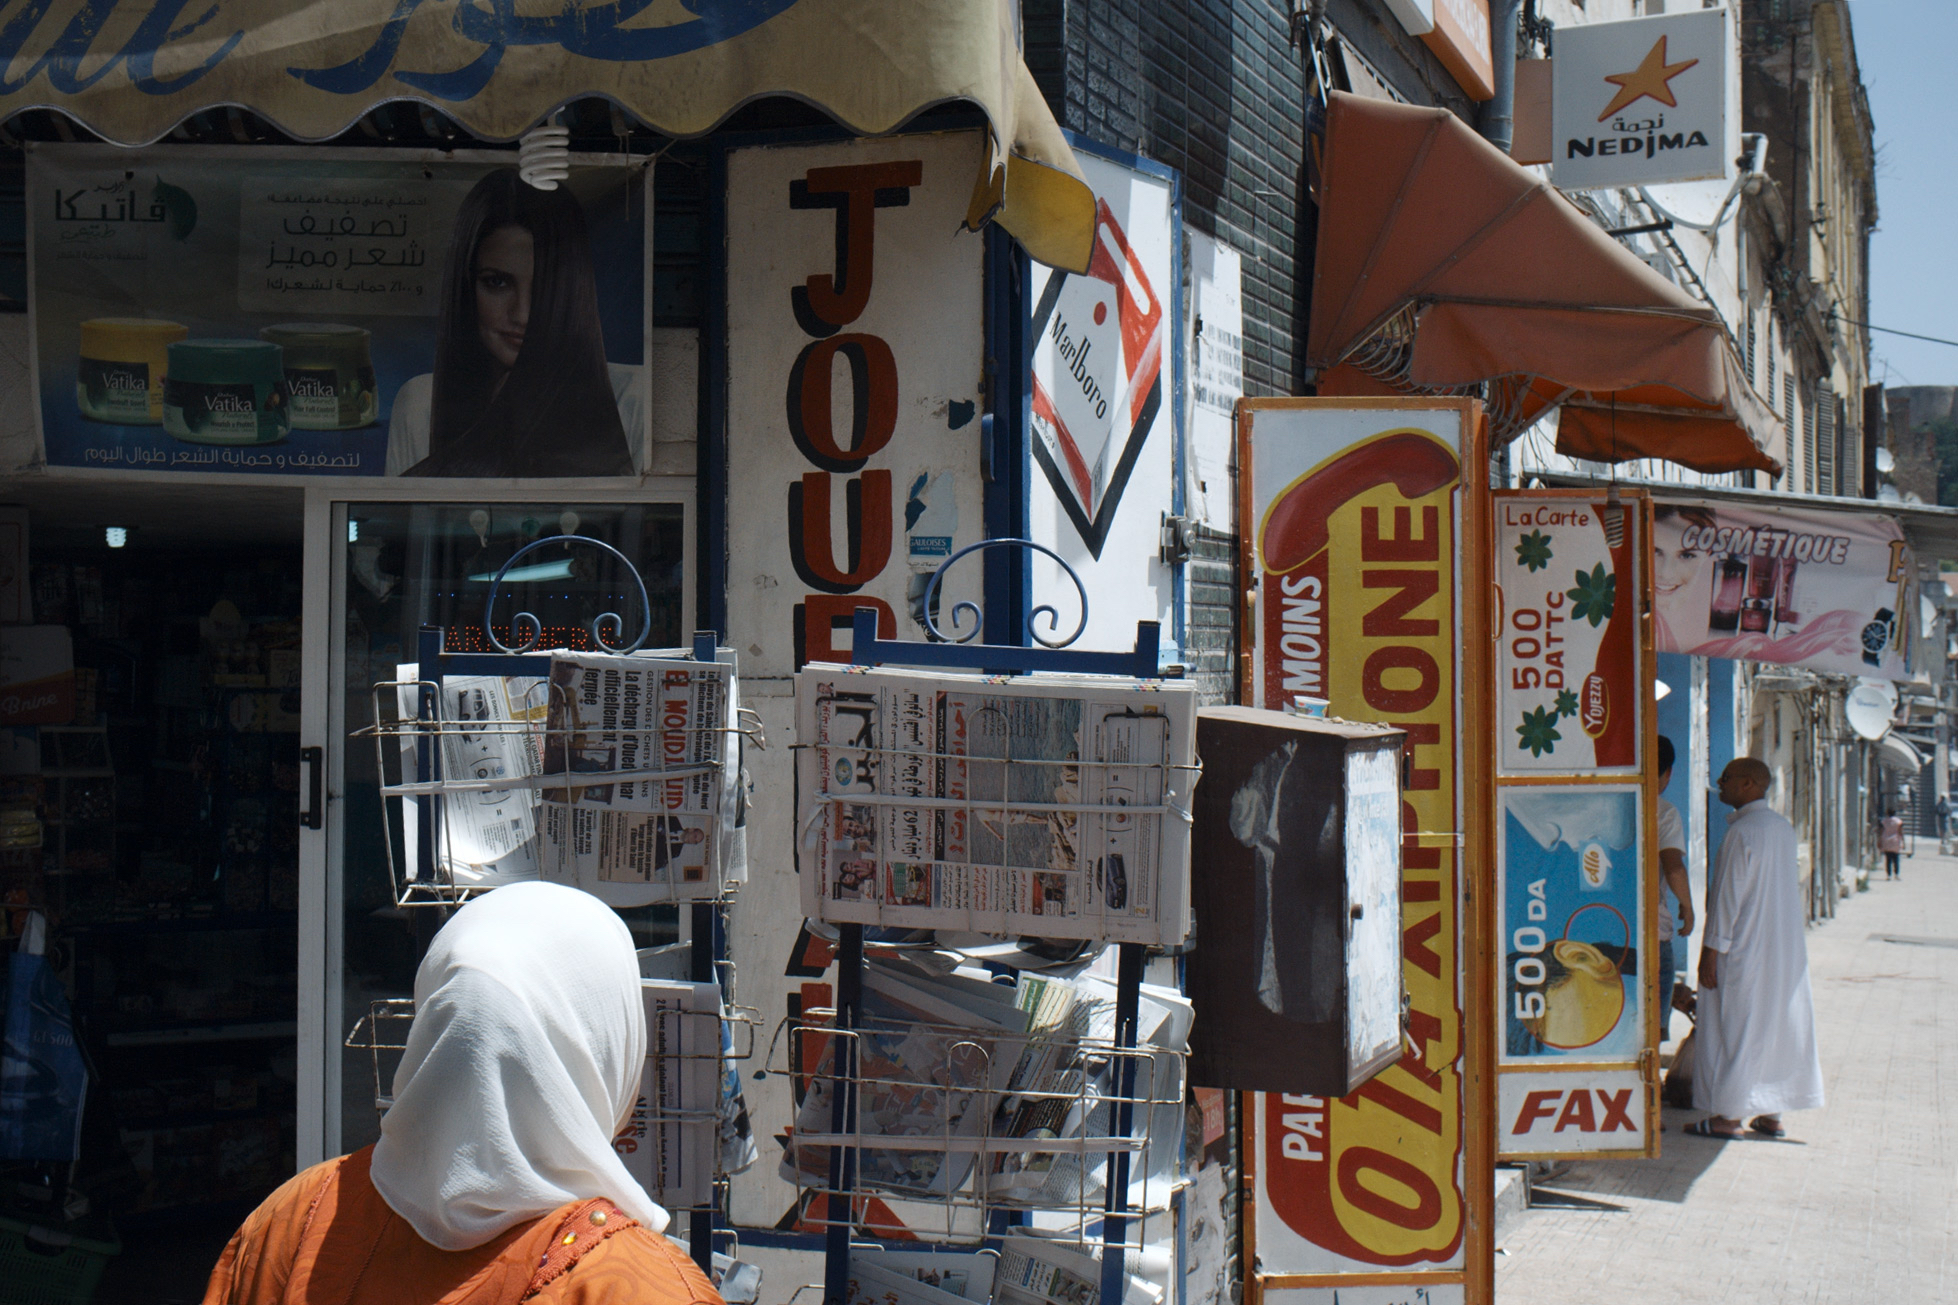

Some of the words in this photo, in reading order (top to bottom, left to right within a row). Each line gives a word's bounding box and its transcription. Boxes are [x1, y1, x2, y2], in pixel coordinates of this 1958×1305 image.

[283, 209, 407, 242] تصفيف
[265, 240, 338, 270] مميز
[343, 239, 425, 271] شعر
[1048, 311, 1108, 420] Marlboro
[102, 372, 147, 392] Vatika
[288, 380, 335, 398] Vatika
[205, 395, 253, 412] Vatika
[84, 445, 124, 463] اليوم
[126, 446, 167, 464] طوال
[169, 446, 219, 466] الشعر
[222, 447, 273, 468] حماية
[276, 454, 285, 469] و
[289, 448, 361, 470] لتصفيف
[1534, 505, 1590, 528] Carte
[1681, 524, 1851, 566] COSMÉTIQUE
[1280, 573, 1323, 693] MOINS
[1511, 607, 1542, 691] 500
[583, 668, 601, 705] fermée
[624, 671, 641, 681] La
[664, 670, 690, 691] EL
[707, 670, 716, 682] Le
[644, 670, 654, 705] GESTION
[697, 679, 707, 712] élicitent
[705, 683, 715, 701] pays
[602, 670, 620, 743] officiellement
[644, 707, 653, 723] DES
[706, 701, 715, 710] du
[696, 713, 705, 721] de
[704, 711, 714, 731] Sahe
[643, 724, 652, 760] DCHETS
[703, 741, 712, 750] de
[704, 732, 713, 741] et
[834, 689, 881, 793] الخبر
[660, 700, 688, 810] MOUDJHID
[701, 781, 710, 791] du
[701, 792, 710, 810] Nord
[949, 781, 965, 840] الوت
[902, 808, 918, 824] 62
[1581, 849, 1601, 886] Allo
[1526, 876, 1548, 922] DA
[1512, 925, 1549, 1021] 500
[657, 1005, 667, 1030] fres
[657, 1031, 667, 1063] adults
[1511, 1088, 1638, 1138] FAX
